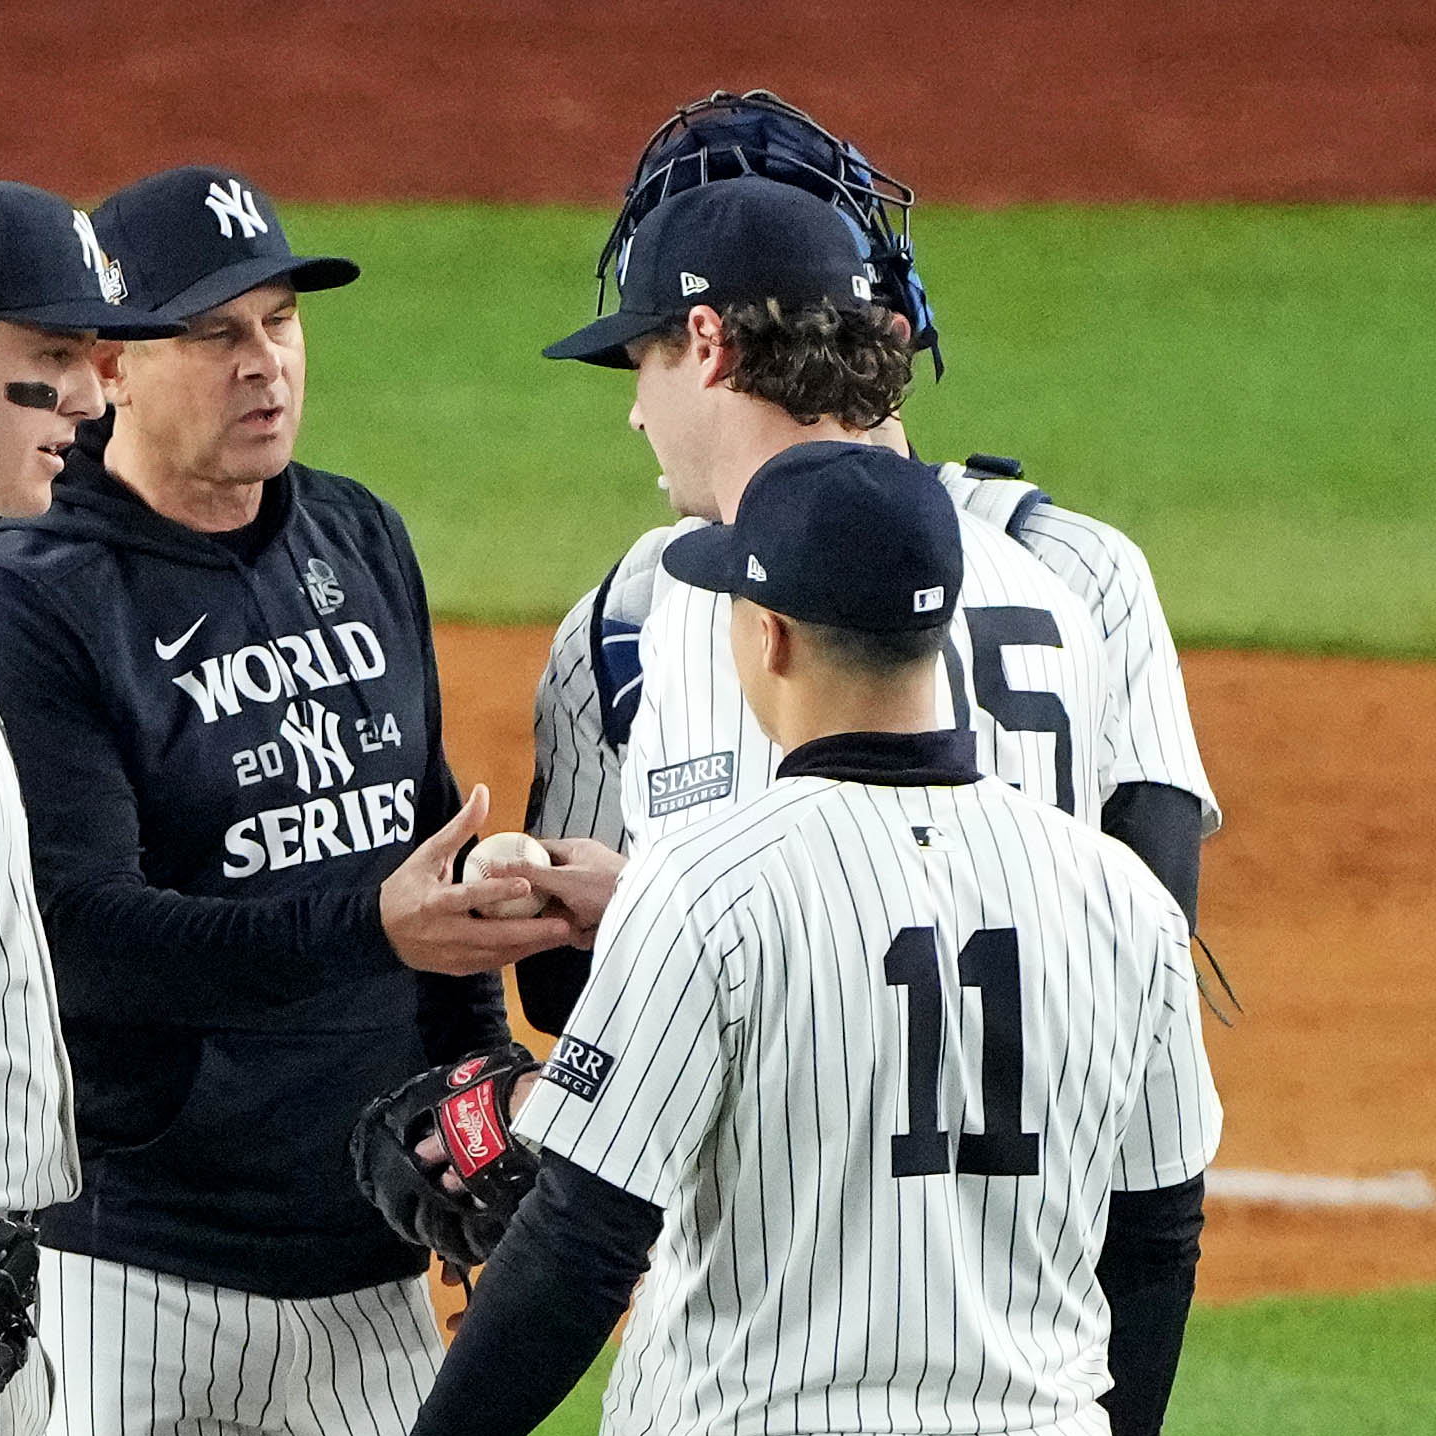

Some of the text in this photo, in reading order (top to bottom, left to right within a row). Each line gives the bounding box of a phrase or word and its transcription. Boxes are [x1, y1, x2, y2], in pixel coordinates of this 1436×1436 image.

[205, 178, 268, 239] NY
[172, 620, 387, 724] WORLD
[232, 699, 402, 794] 20 NY 24
[651, 754, 730, 797] STARR
[222, 778, 416, 879] SERIES
[652, 784, 728, 815] INSURANCE
[883, 926, 1040, 1178] 11
